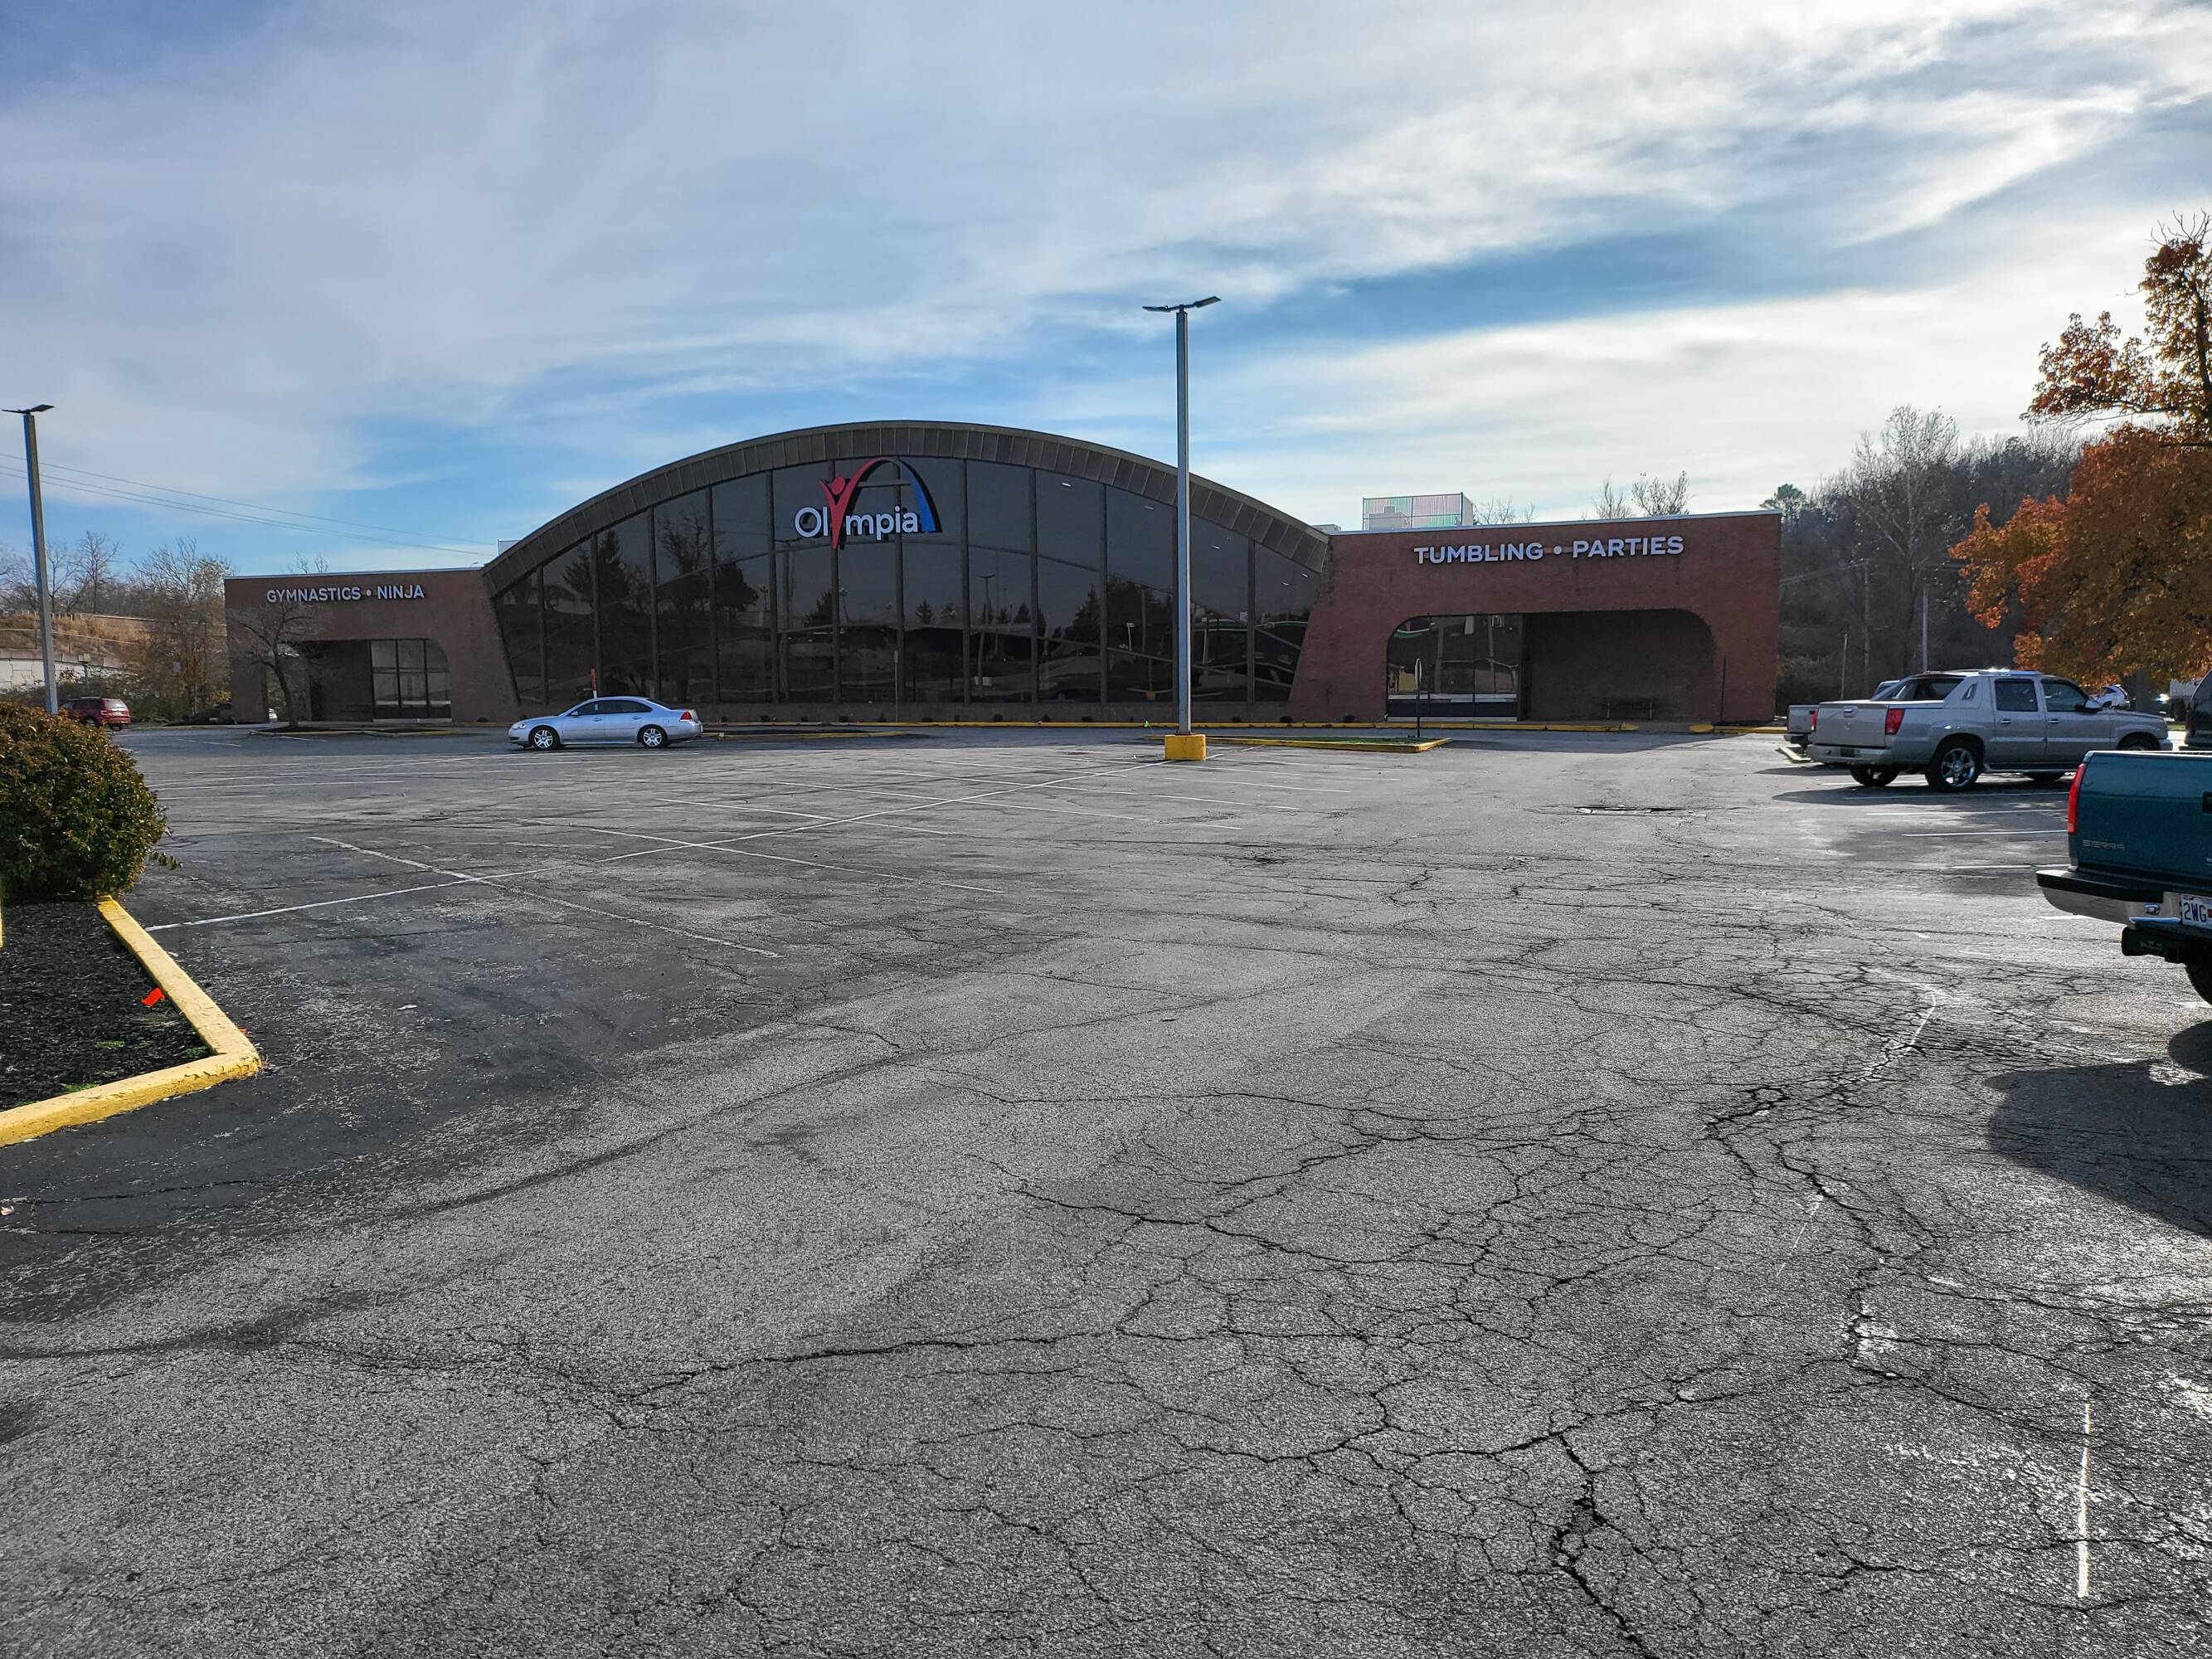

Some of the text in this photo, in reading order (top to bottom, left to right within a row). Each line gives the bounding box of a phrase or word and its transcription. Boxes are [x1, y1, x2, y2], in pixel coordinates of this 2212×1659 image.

[794, 481, 919, 549] Olympia
[1413, 536, 1685, 565] TUMBLING PARTIES
[266, 584, 425, 603] GYMNASTICS NINJA
